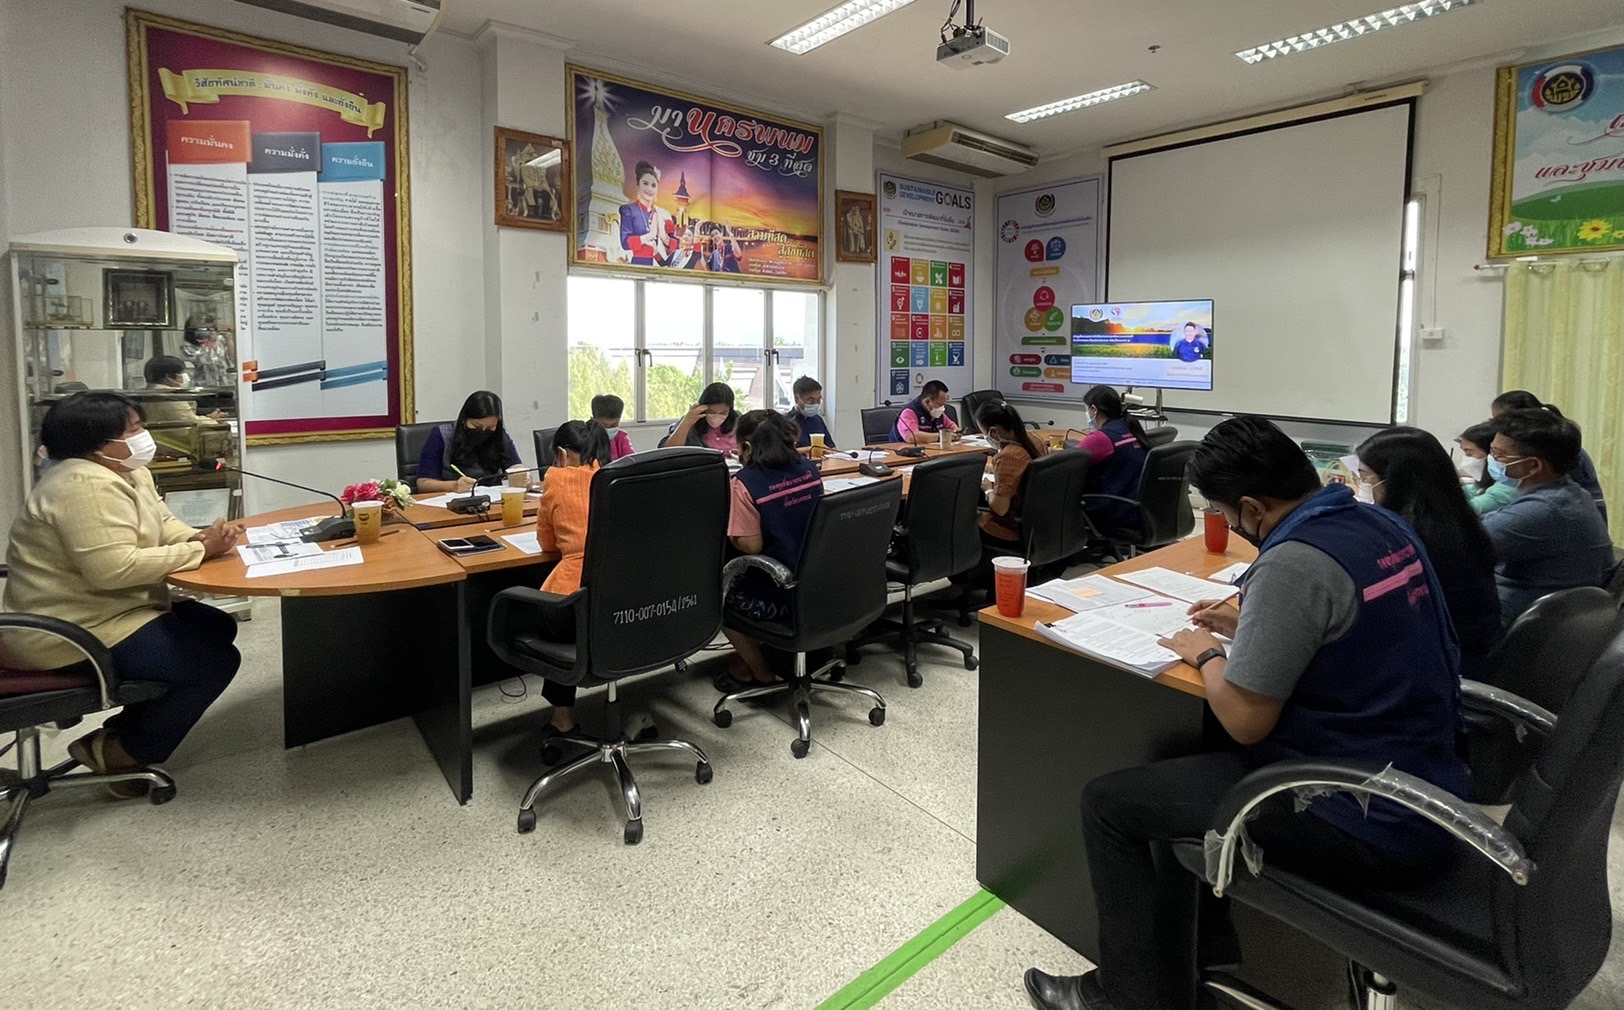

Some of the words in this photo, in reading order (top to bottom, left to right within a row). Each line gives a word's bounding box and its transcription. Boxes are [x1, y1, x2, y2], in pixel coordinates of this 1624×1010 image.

[769, 153, 779, 165] 3
[899, 183, 936, 196] SUSTAINABLE
[899, 191, 936, 203] DEVELOPMENT
[935, 190, 972, 210] GOALS
